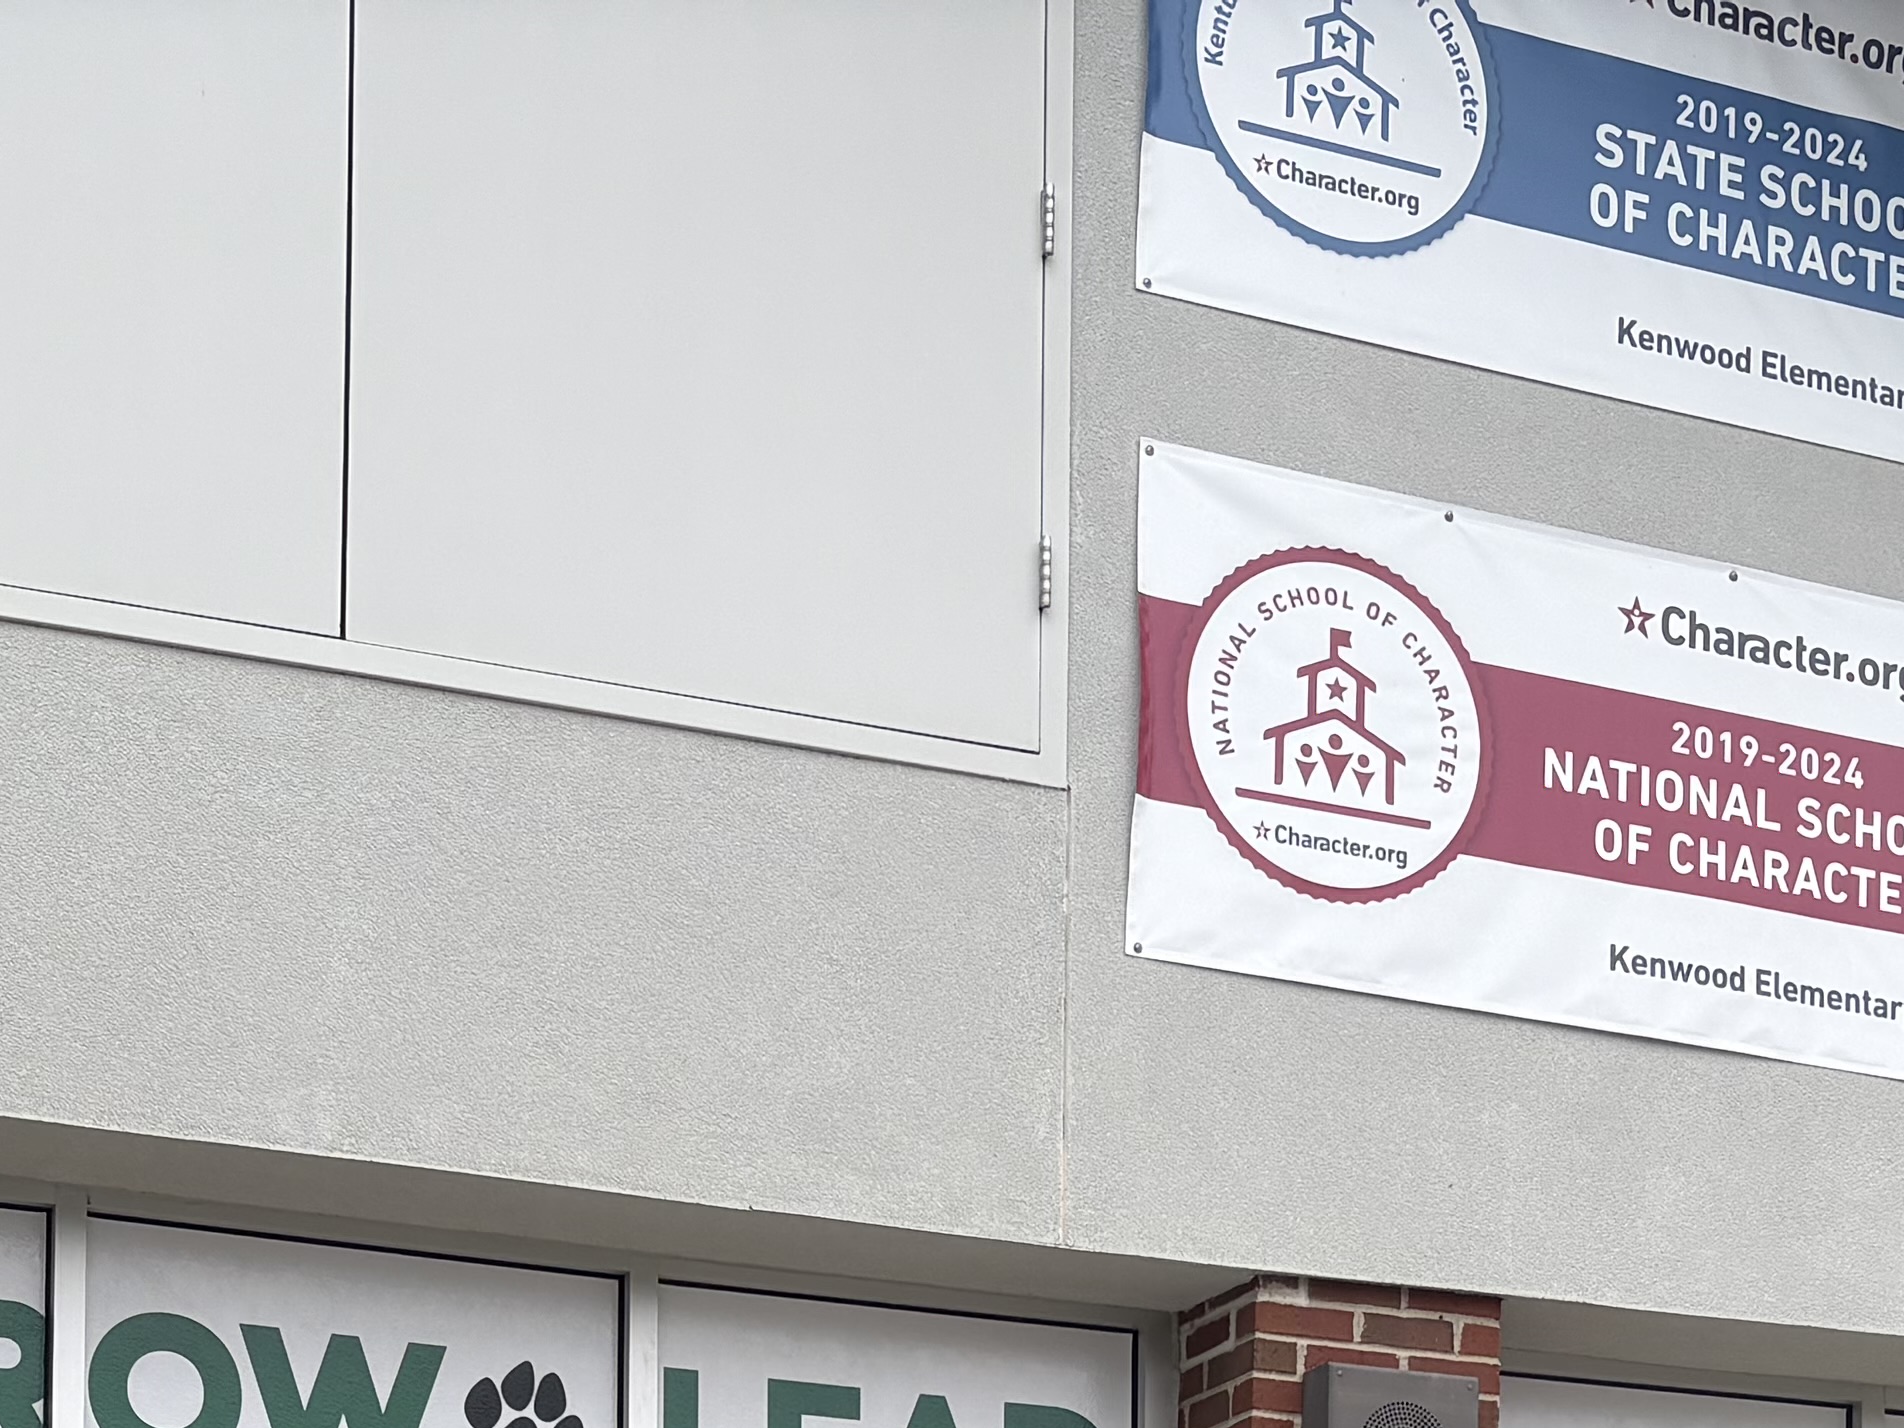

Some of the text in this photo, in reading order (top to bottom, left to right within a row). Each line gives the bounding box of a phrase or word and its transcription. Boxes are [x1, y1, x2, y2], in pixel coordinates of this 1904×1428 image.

[1429, 8, 1479, 136] Character
[1594, 123, 1746, 200] STATE
[1675, 94, 1868, 173] 2019-2024
[1276, 157, 1420, 216] Character.org
[1589, 183, 1650, 234] OF
[1617, 316, 1752, 374] Kenwood
[1211, 586, 1459, 794] NATIONAL SCHOOL OF CHARACTER
[1671, 721, 1865, 790] 2019-2024
[1542, 746, 1782, 832] NATIONAL
[1274, 824, 1408, 870] Character.org
[1594, 818, 1653, 866] OF
[1609, 943, 1746, 993] Kenwood
